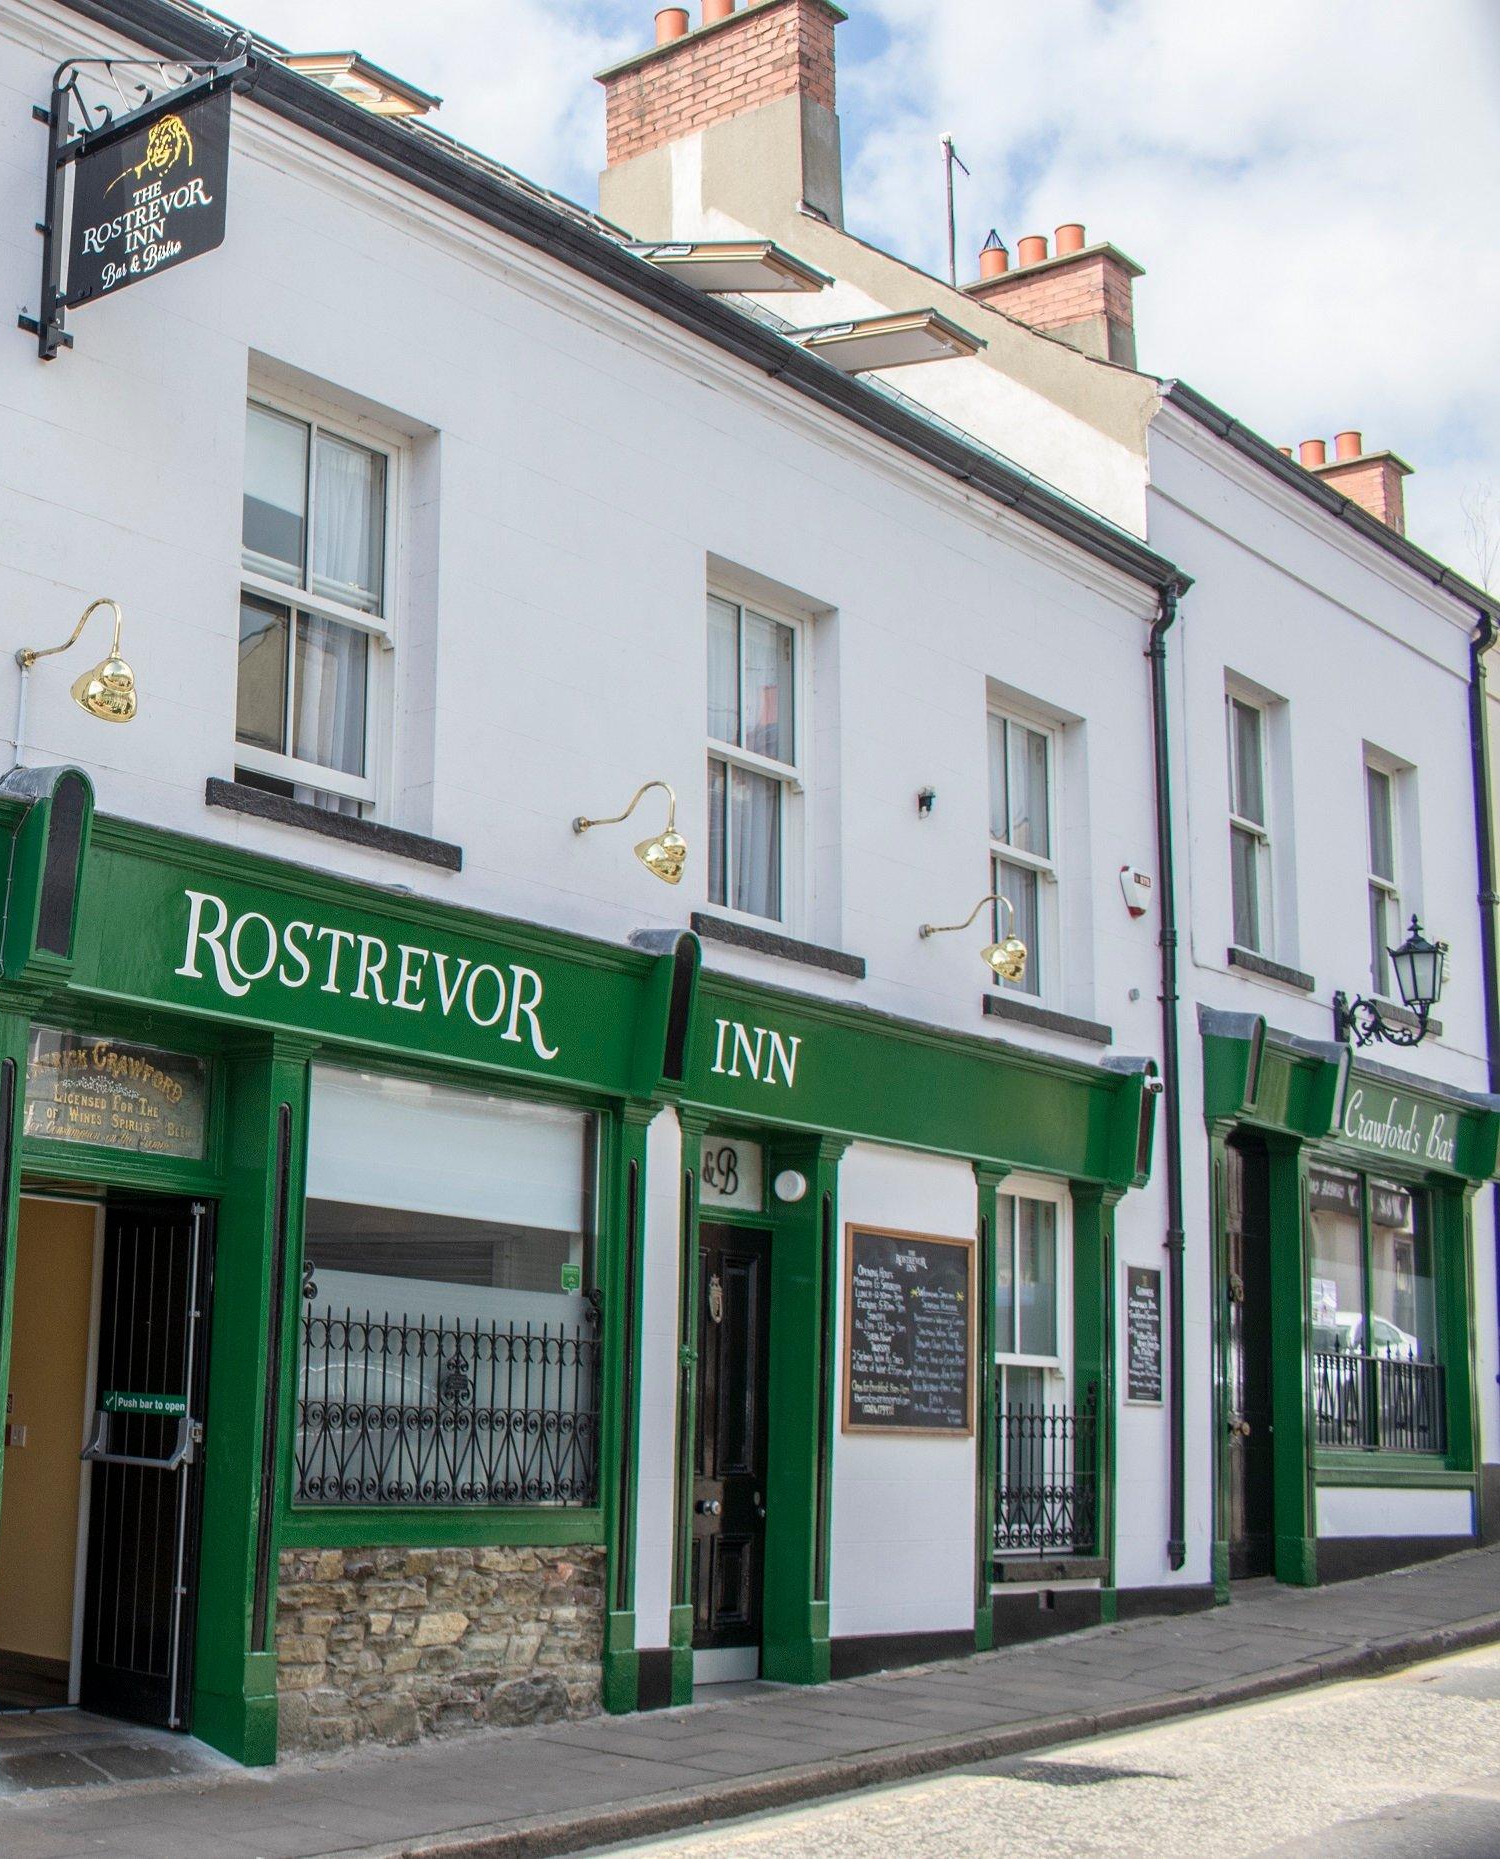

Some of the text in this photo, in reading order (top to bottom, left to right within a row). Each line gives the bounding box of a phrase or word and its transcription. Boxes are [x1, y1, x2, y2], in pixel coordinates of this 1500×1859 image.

[82, 177, 213, 255] ROSTREVOR
[133, 181, 162, 206] THE
[102, 239, 182, 290] Bar & Bistro
[125, 218, 166, 253] INN
[175, 889, 559, 1060] ROSTREVOR
[711, 1018, 802, 1089] INN
[1345, 1089, 1455, 1163] Crawford's Bar
[118, 1397, 186, 1414] Push bar to open
